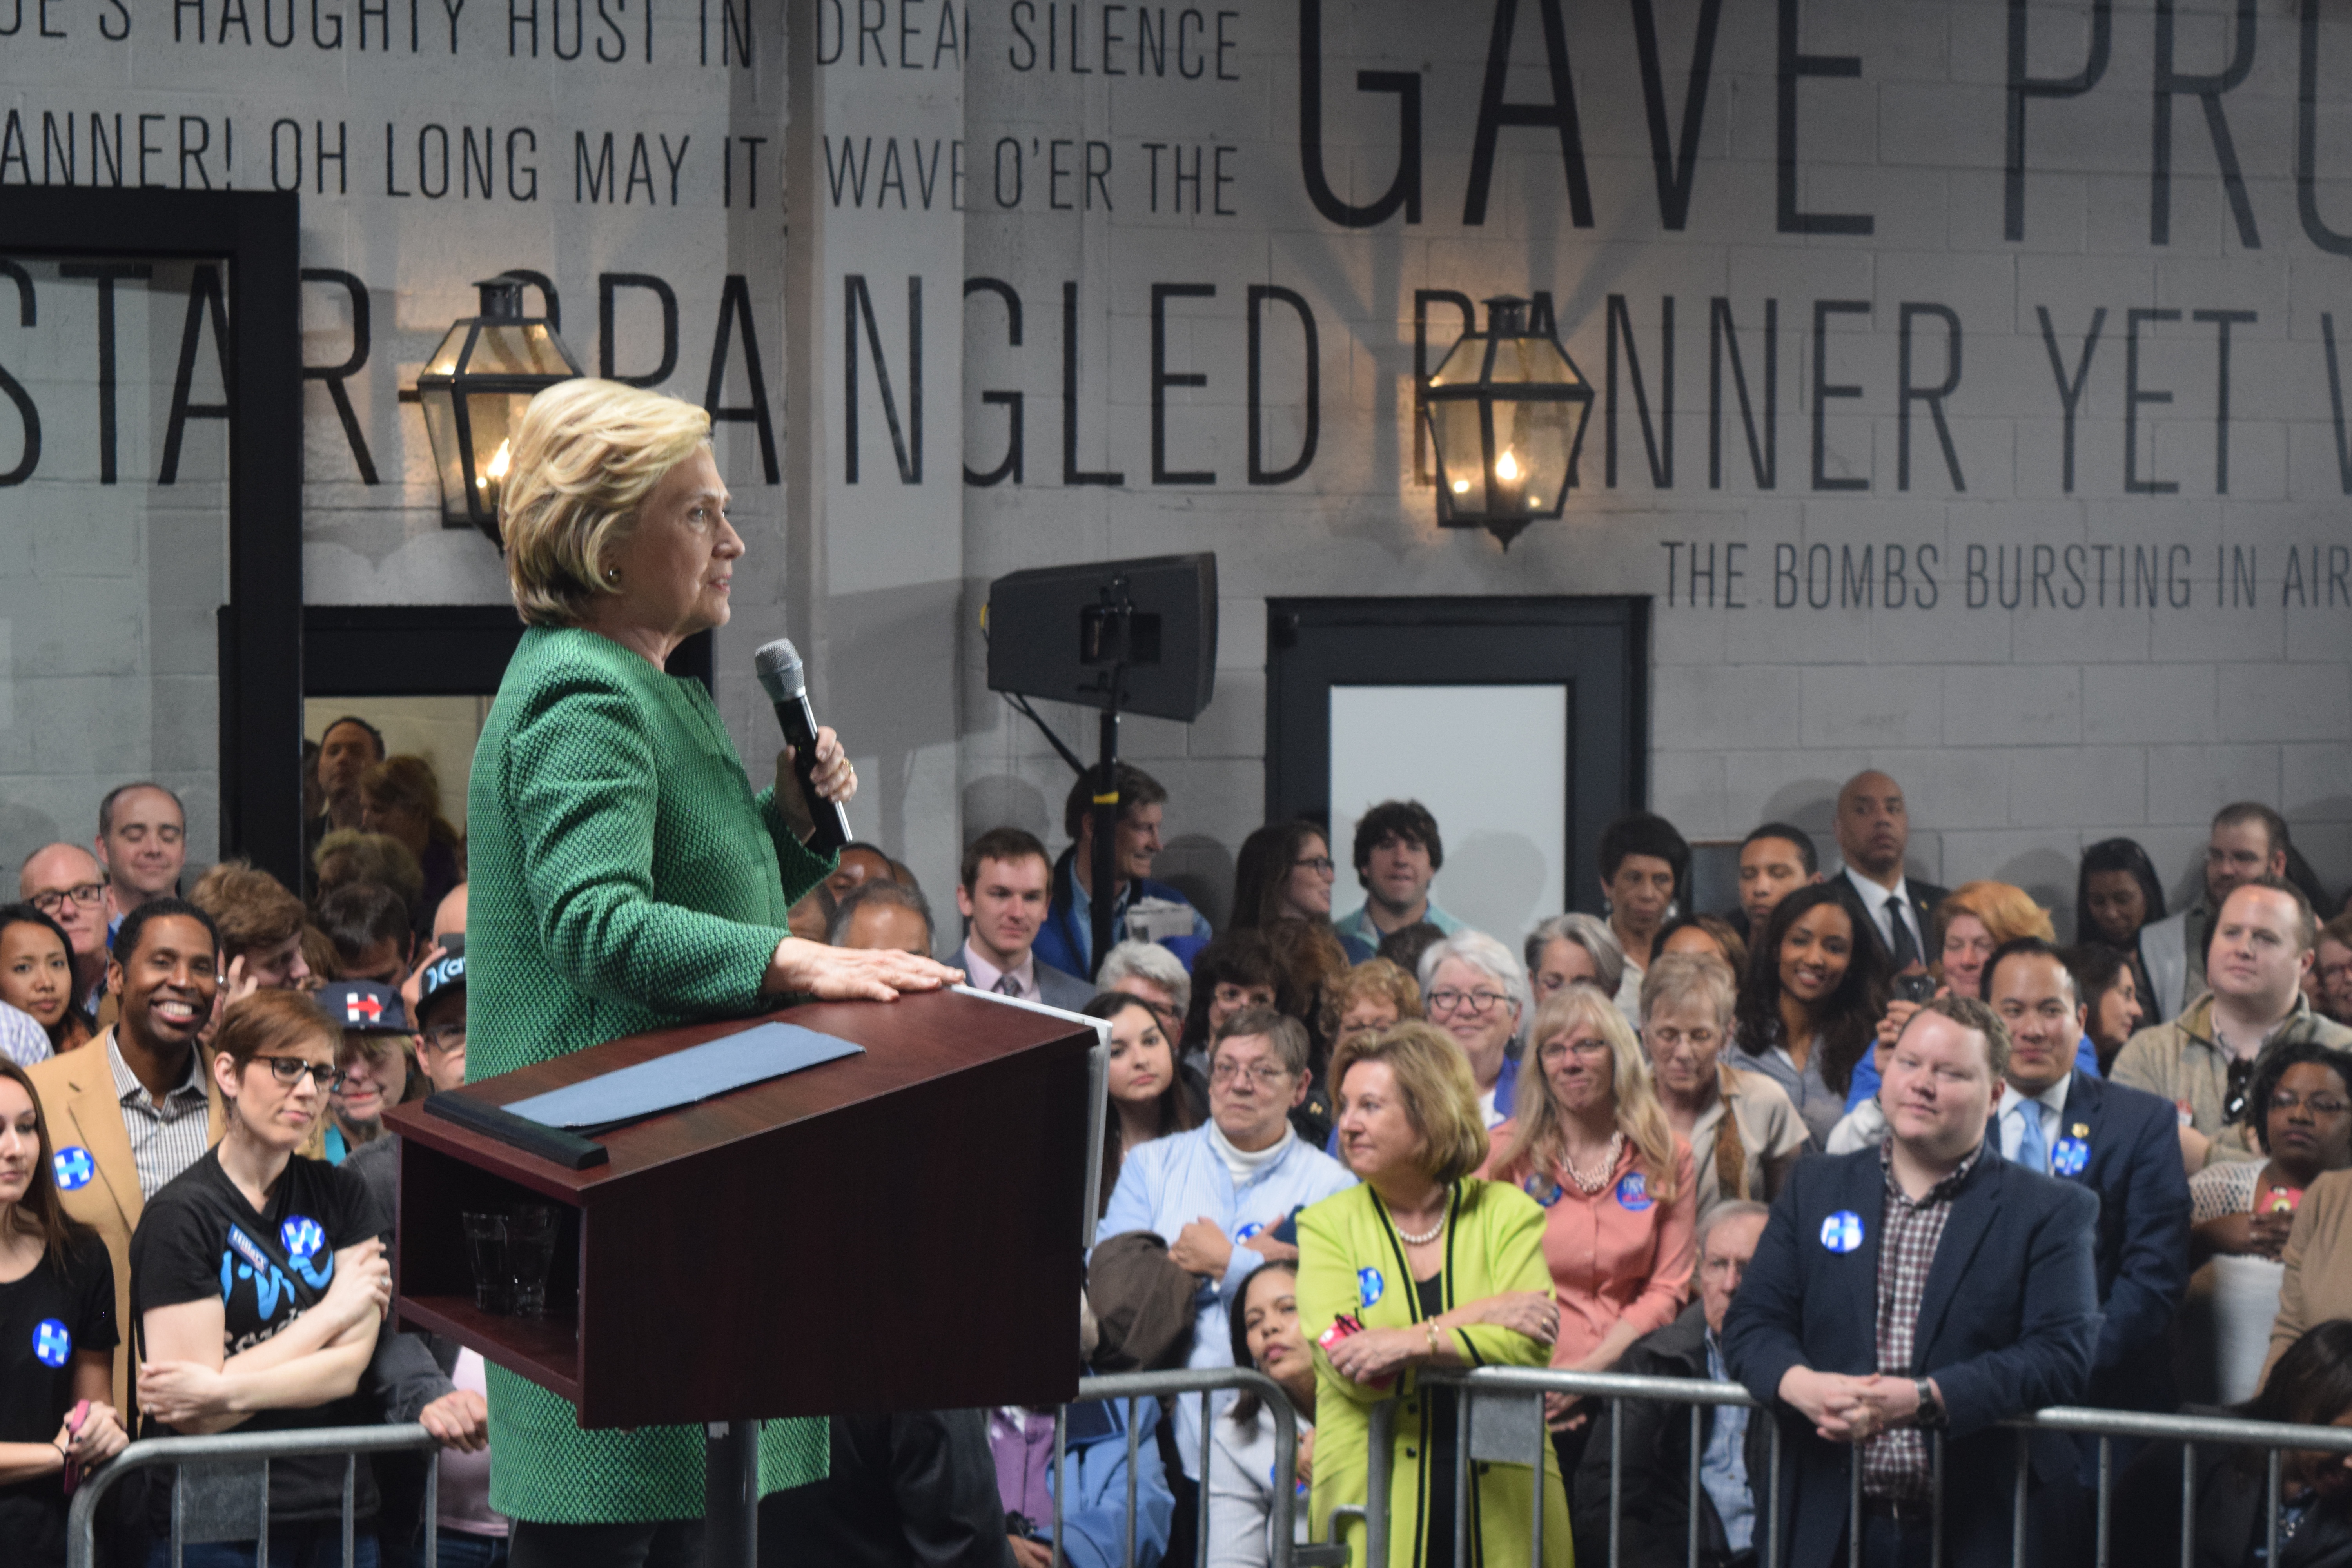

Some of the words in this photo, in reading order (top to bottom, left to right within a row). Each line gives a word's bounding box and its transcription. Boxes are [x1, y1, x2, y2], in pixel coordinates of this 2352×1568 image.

[175, 0, 465, 54] HAUGHTY
[701, 0, 751, 68] IN
[816, 0, 969, 70] DREA
[1009, 1, 1240, 80] SILENCE
[1299, 0, 1874, 235] GAVE
[271, 118, 347, 194] OH
[387, 122, 537, 201] LONG
[575, 131, 690, 206] MAY
[724, 136, 768, 209] IT
[823, 135, 965, 211] WAVE
[995, 136, 1113, 212] O'ER
[1141, 143, 1238, 216] THE
[2036, 305, 2258, 495] YET
[1660, 541, 1748, 609] THE
[1774, 543, 1938, 610] BOMBS
[1966, 543, 2192, 610] BURSTING
[2217, 544, 2257, 608] IN
[2282, 544, 2352, 608] AIR
